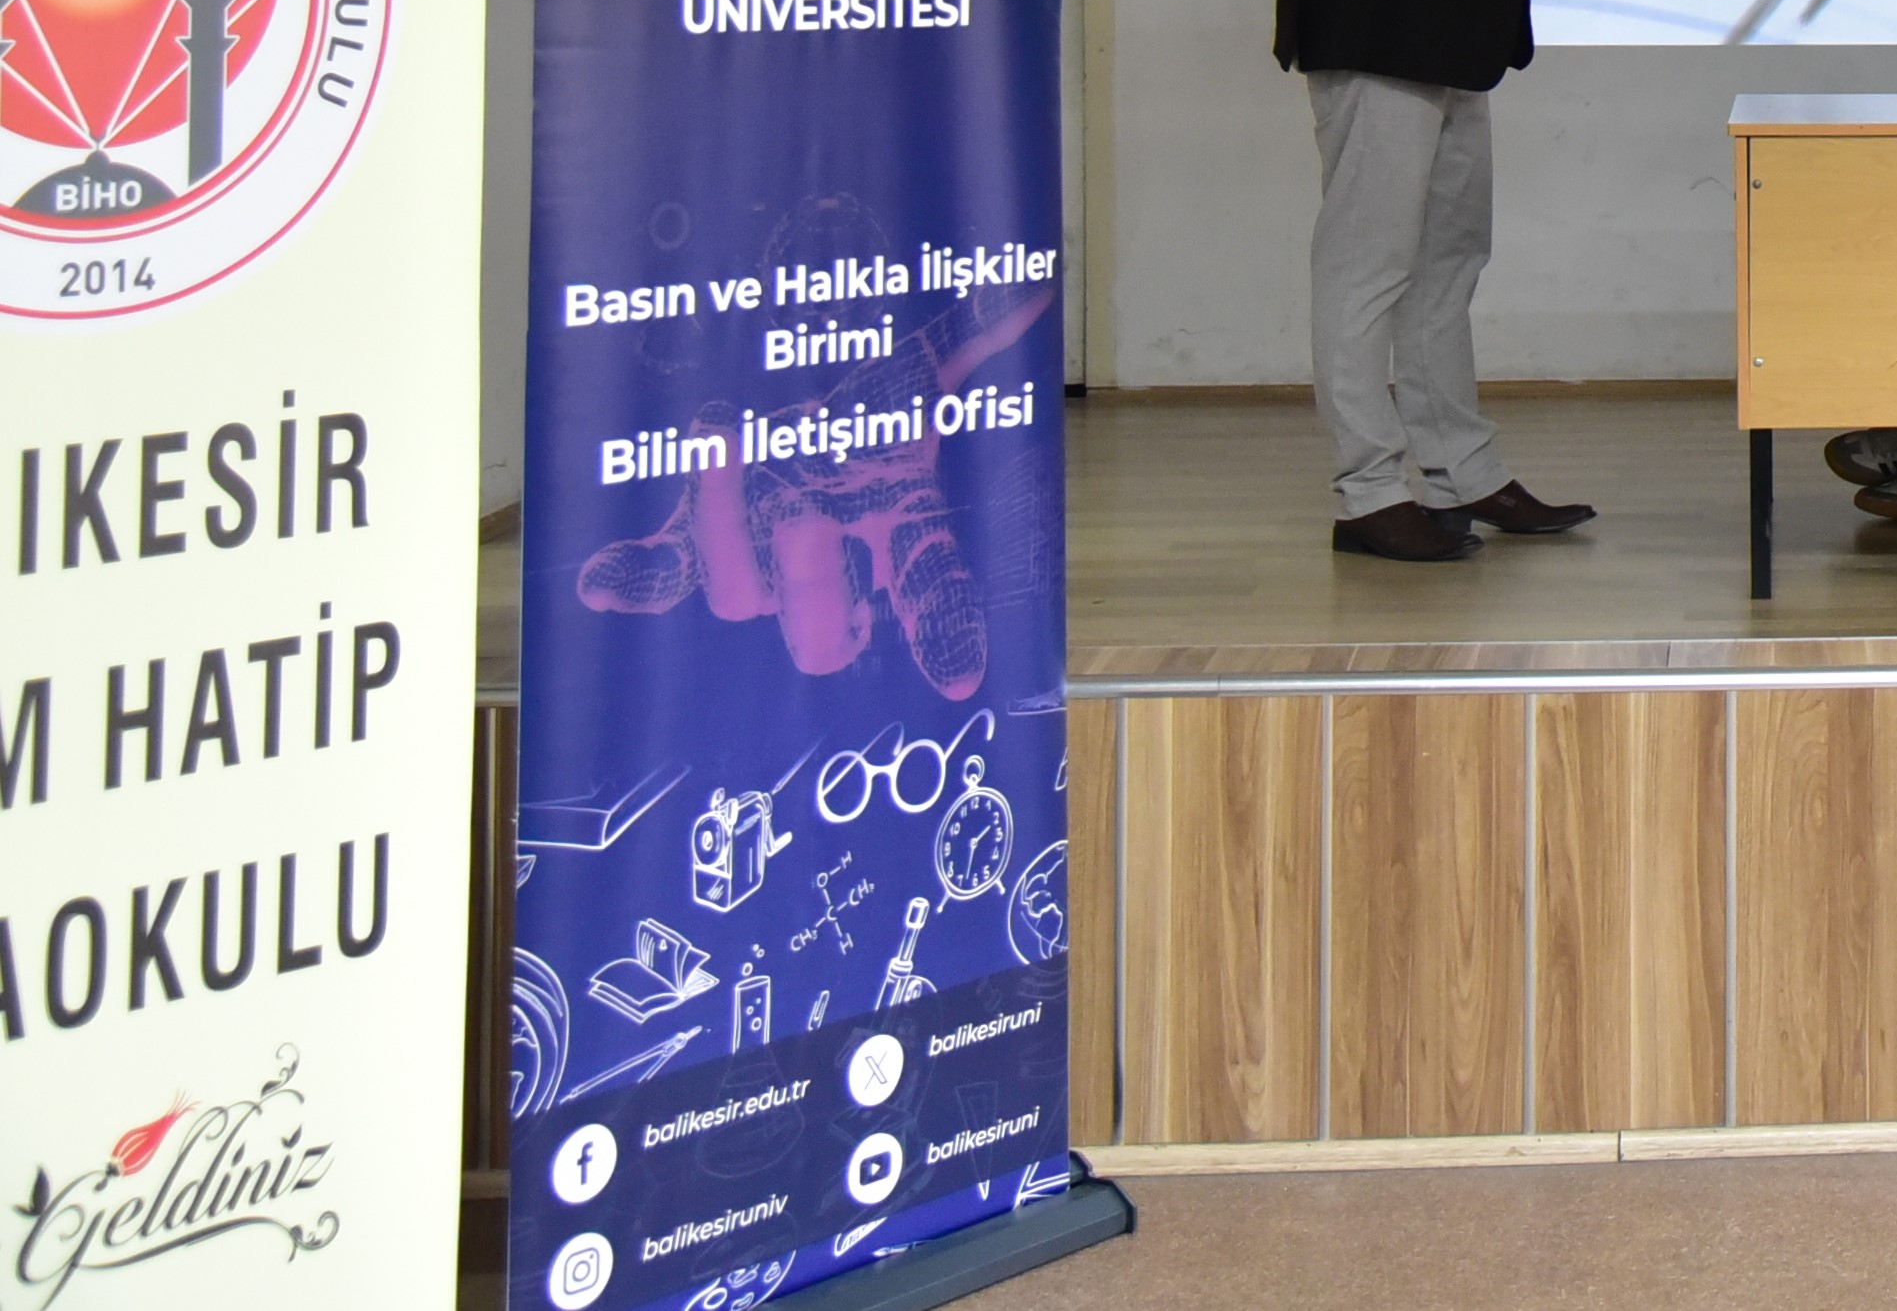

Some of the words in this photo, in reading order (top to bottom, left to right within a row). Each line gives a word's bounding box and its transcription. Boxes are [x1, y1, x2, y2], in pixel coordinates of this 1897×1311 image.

[55, 177, 144, 212] BİHO
[59, 257, 157, 298] 2014
[565, 281, 696, 327] Basın
[709, 275, 762, 312] ve
[774, 255, 909, 306] Halkla
[920, 241, 1056, 298] İlişkiler
[763, 315, 893, 370] Birimi
[600, 426, 727, 485] Bilim
[742, 395, 923, 463] İletişimi
[932, 382, 1034, 436] Ofisi
[103, 600, 401, 791] HATİP
[928, 1001, 1042, 1057] balikesiruni
[643, 1077, 811, 1149] balikesir.edu.tr
[926, 1105, 1040, 1164] balikesiruni
[14, 1097, 336, 1311] Geldiniz
[642, 1192, 789, 1262] balikesiruniv
